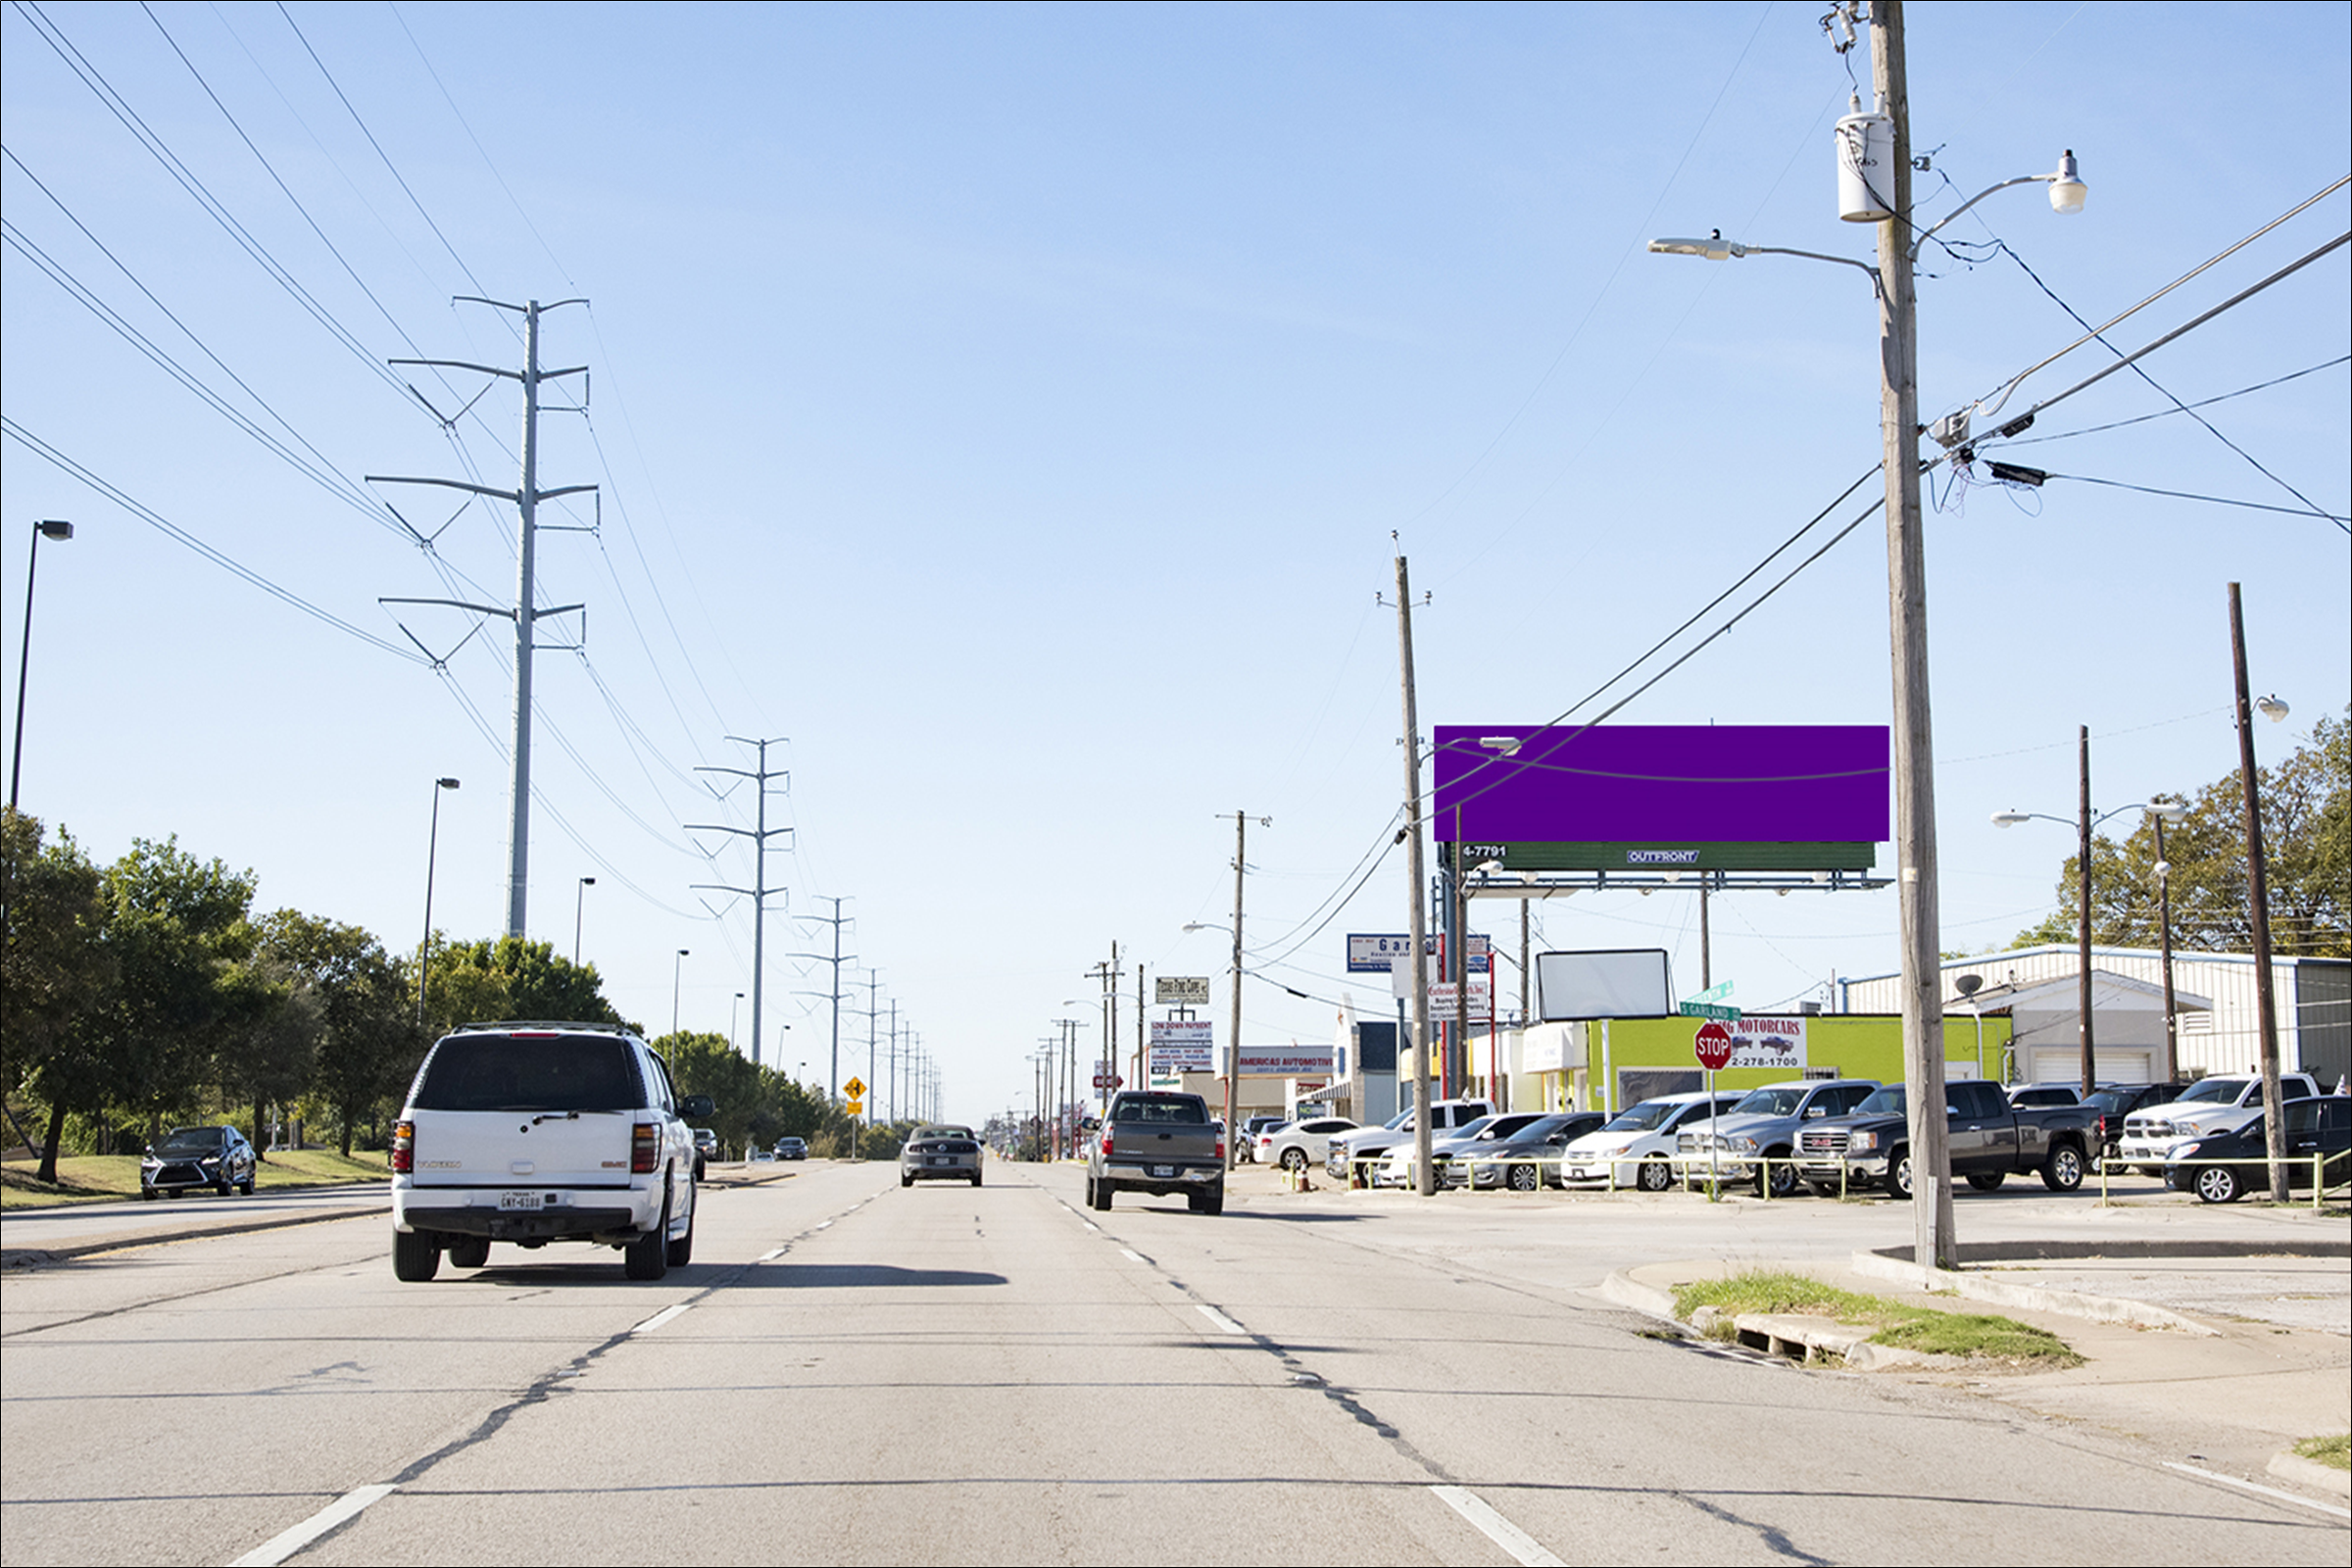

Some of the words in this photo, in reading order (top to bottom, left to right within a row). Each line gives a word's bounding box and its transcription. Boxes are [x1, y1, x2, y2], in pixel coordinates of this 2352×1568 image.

[1630, 851, 1697, 862] OUTFRONT
[1682, 1003, 1688, 1015] S
[1690, 1004, 1729, 1019] GARLAND
[1738, 1019, 1800, 1036] MOTORCARS
[1697, 1037, 1729, 1056] STOP
[1240, 1057, 1281, 1066] AMERICAS
